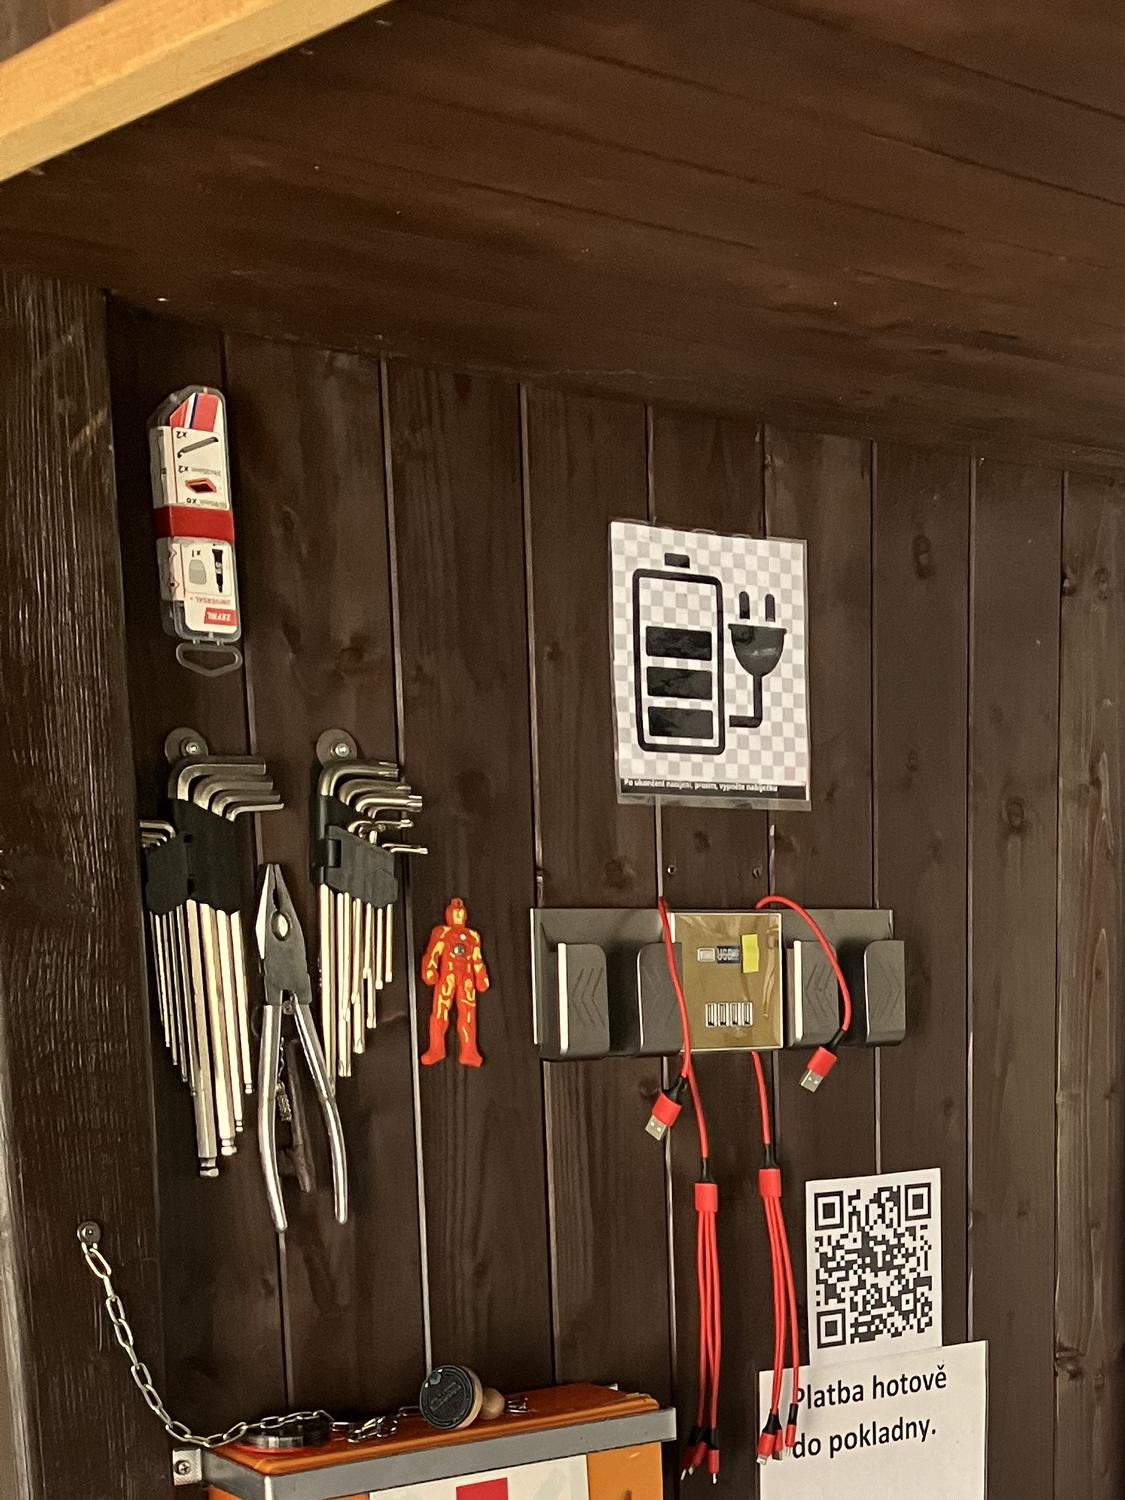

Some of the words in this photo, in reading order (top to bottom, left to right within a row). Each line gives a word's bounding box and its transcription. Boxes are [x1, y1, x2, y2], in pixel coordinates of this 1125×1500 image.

[872, 1363, 947, 1400] hotově
[792, 1432, 821, 1459] do
[829, 1416, 936, 1459] pokladny.
